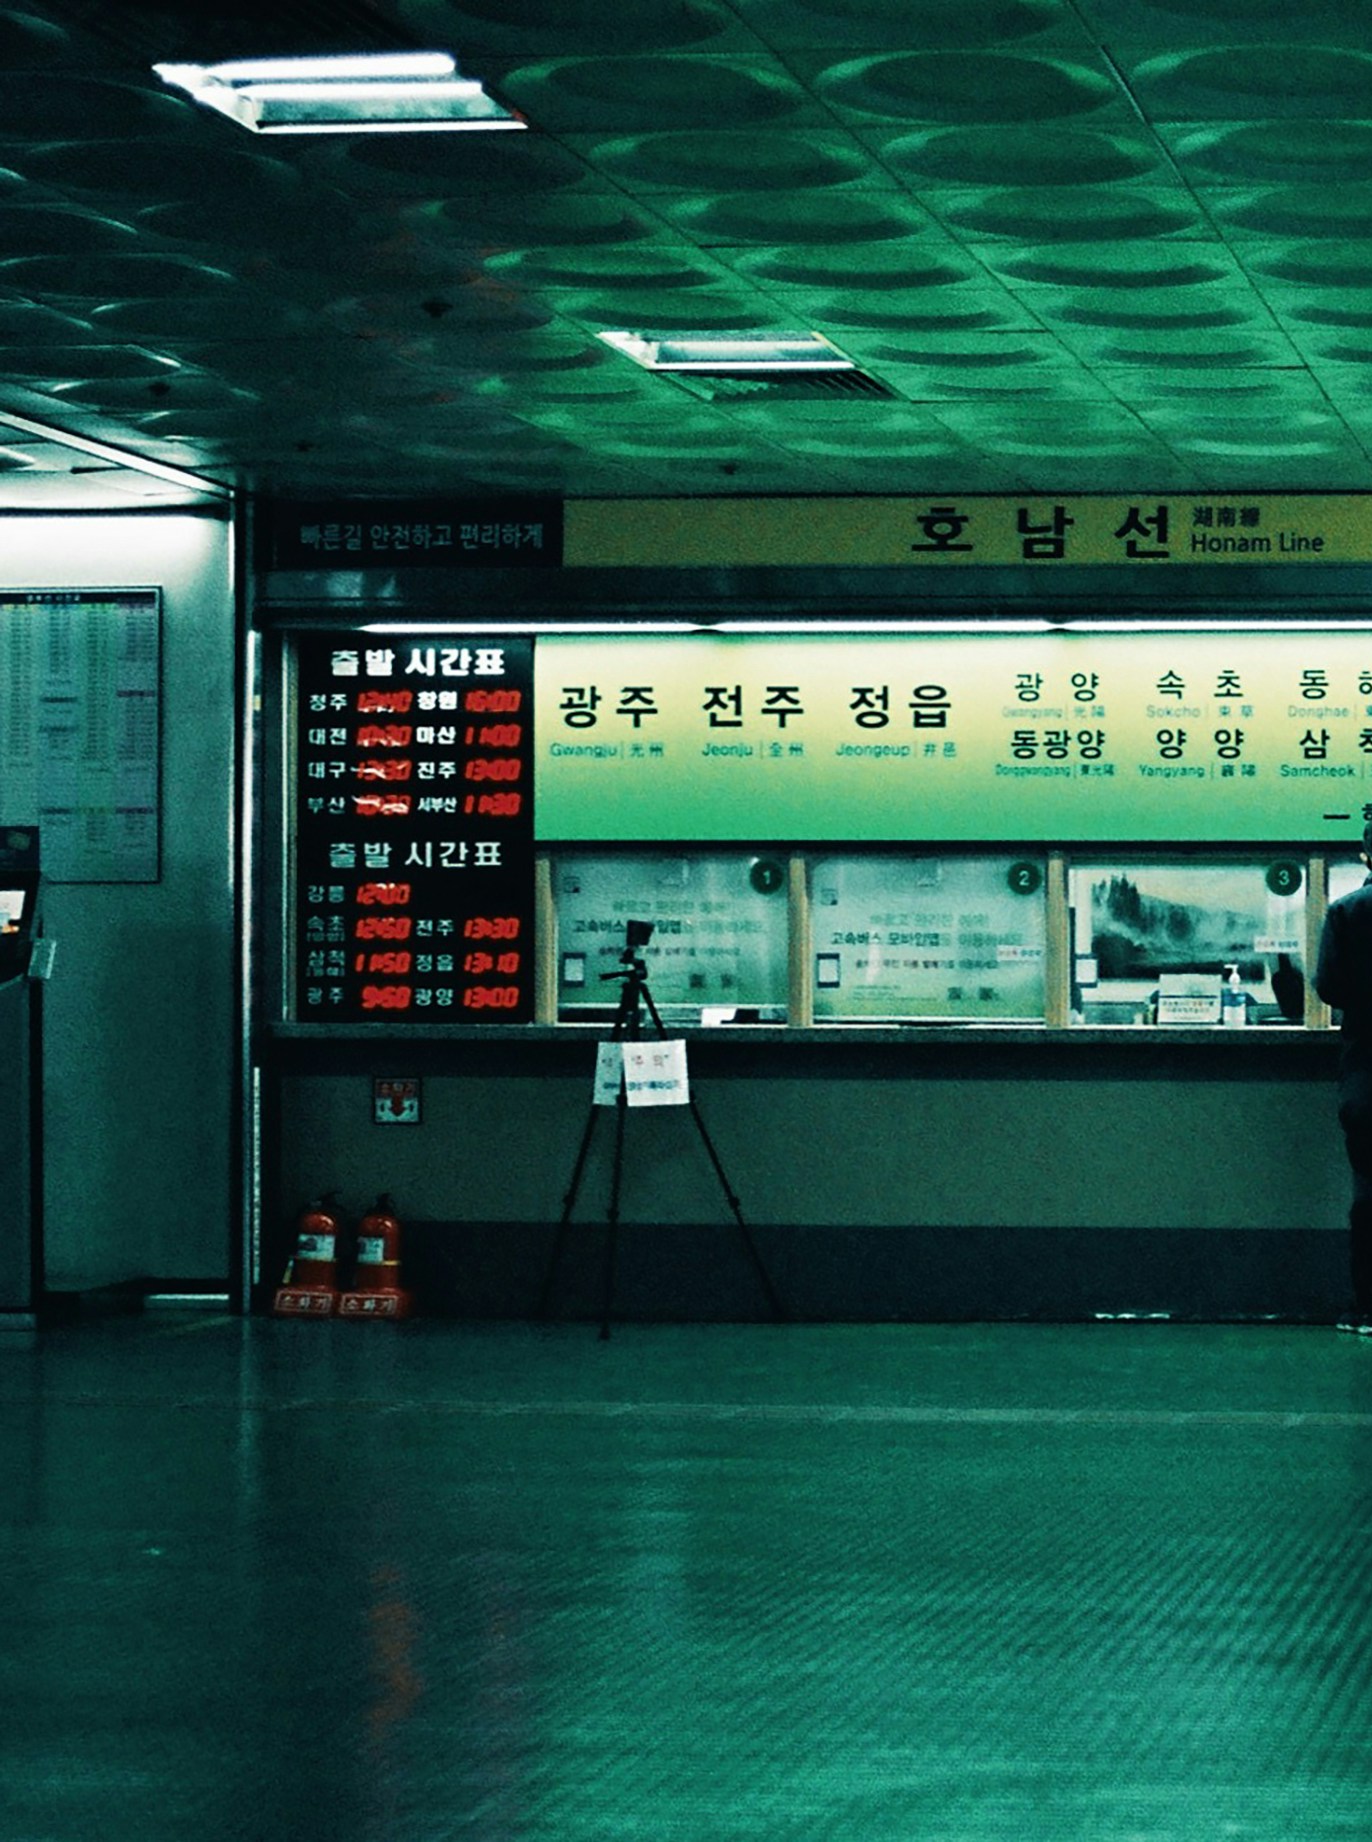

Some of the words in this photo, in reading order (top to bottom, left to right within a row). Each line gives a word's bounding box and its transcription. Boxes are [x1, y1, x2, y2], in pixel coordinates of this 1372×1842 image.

[300, 524, 362, 550] 빠른길
[370, 524, 452, 550] 안전하고
[460, 523, 543, 549] 편리하게
[911, 505, 1169, 559] 호남선
[1191, 533, 1271, 554] Honam
[1279, 532, 1324, 553] Line
[331, 649, 395, 676] 출발
[405, 648, 505, 676] 시간표
[1014, 672, 1100, 702] 광양
[1156, 669, 1244, 699] 속초
[559, 685, 658, 729] 광주
[702, 684, 804, 729] 전주
[849, 684, 951, 729] 정읍
[1146, 705, 1201, 719] Sokcho
[1287, 705, 1350, 720] Donghae
[308, 727, 347, 745] 대전
[416, 726, 456, 744] 마산
[1010, 729, 1106, 759] 동광양
[1156, 728, 1245, 759] 양양
[550, 743, 617, 759] Gwangju
[702, 742, 753, 758] Jeonju
[835, 743, 911, 759] Jeongeup
[308, 761, 346, 778] 대구
[417, 762, 456, 779] 진주
[1139, 764, 1205, 779] Yangyang
[1280, 764, 1355, 778] Samcheok
[308, 797, 345, 814] 부산
[417, 797, 457, 813] 서부산
[330, 843, 392, 868] 출발
[405, 842, 502, 868] 시간표
[764, 871, 772, 885] 1
[1020, 870, 1030, 886] 2
[1278, 871, 1290, 886] 3
[416, 919, 453, 936] 전주
[416, 954, 453, 972] 정읍
[415, 988, 453, 1006] 광양
